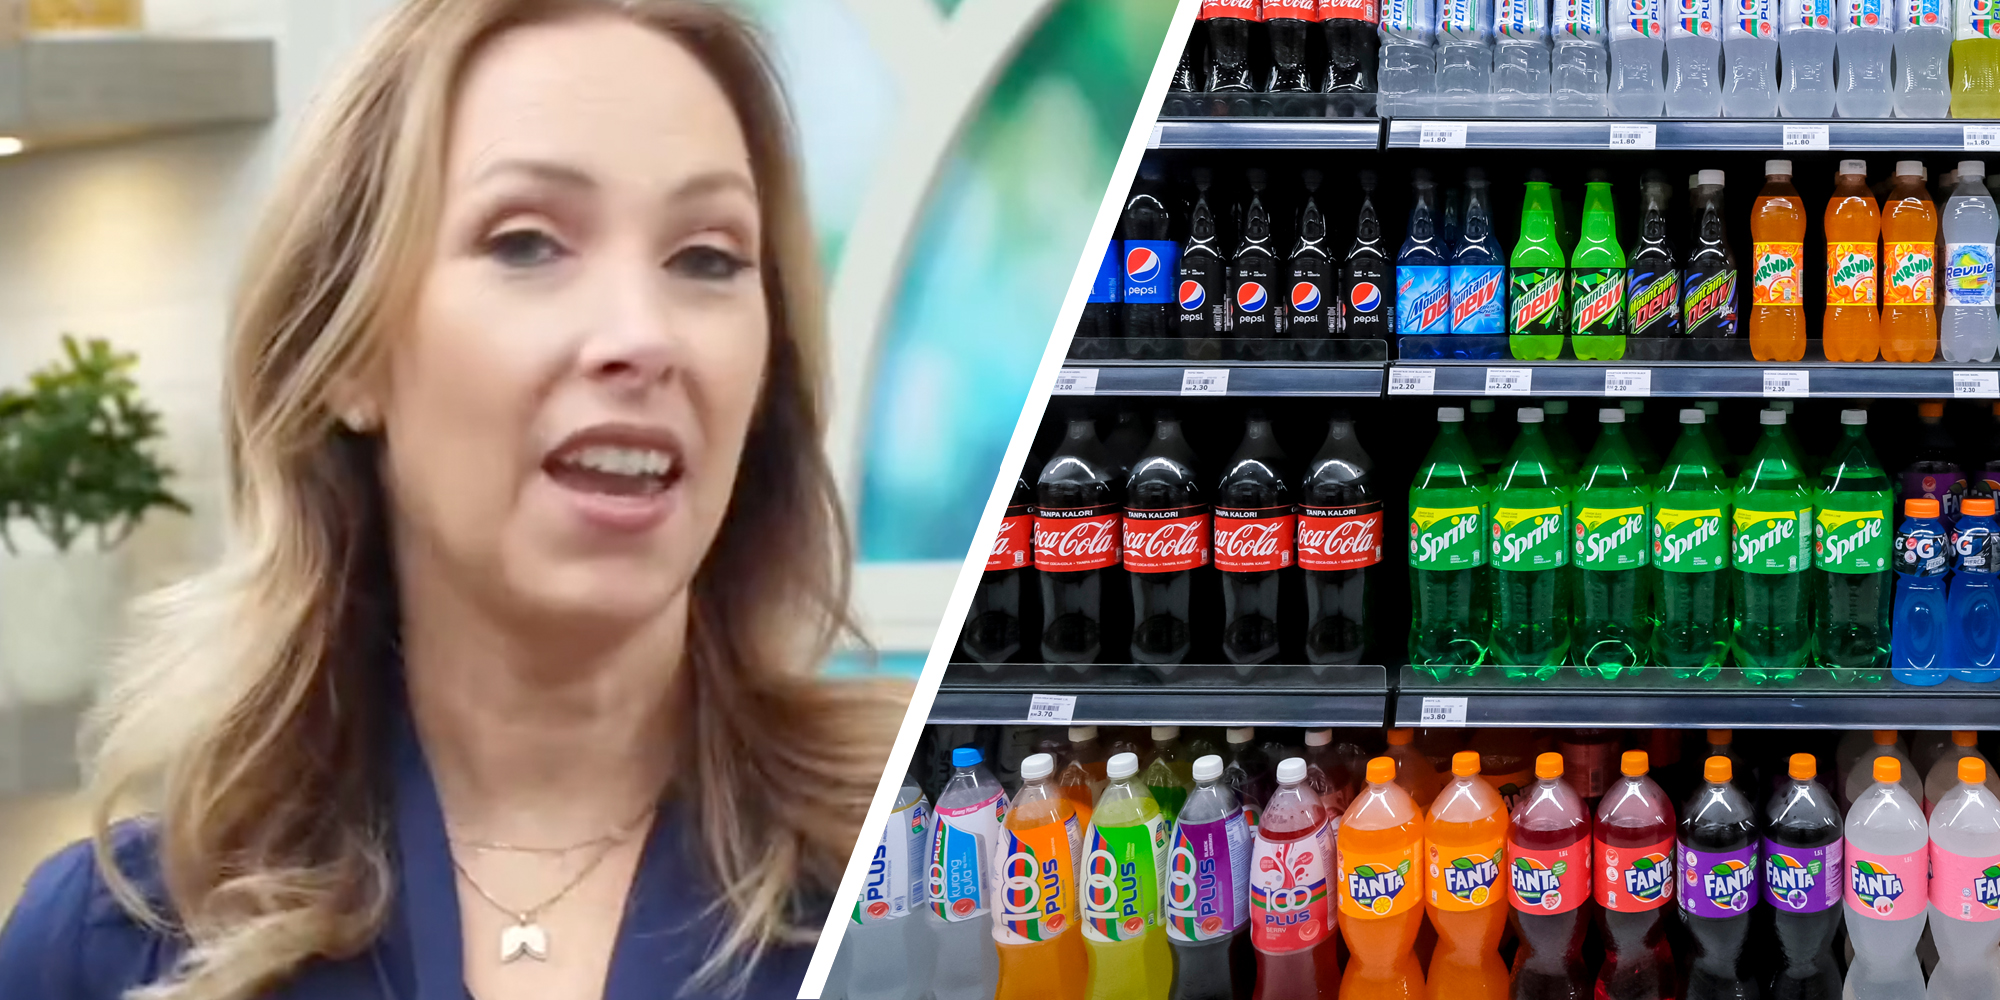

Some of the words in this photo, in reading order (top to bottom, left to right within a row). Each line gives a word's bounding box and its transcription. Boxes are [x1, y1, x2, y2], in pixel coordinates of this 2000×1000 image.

[1755, 256, 1795, 287] MIRINDA
[1834, 256, 1876, 286] MIRINDA
[1892, 256, 1932, 287] MIRINDA
[1128, 286, 1157, 296] pepsi
[1410, 280, 1450, 320] Mounta
[1511, 276, 1555, 317] Mountain
[1572, 276, 1616, 317] Mountain
[1630, 276, 1672, 315] Mountain
[1180, 313, 1204, 322] pepsi
[1240, 314, 1265, 324] pepsi
[1294, 314, 1318, 324] pepsi
[1354, 314, 1380, 324] pepsi
[1298, 518, 1377, 556] Coca-Cola
[1419, 514, 1477, 562] Sprite
[1502, 514, 1560, 563] Sprite
[1586, 514, 1642, 562] Sprite
[1663, 516, 1719, 563] Sprite
[1738, 519, 1794, 564] Sprite
[1825, 518, 1881, 564] Sprite
[1916, 538, 1934, 558] G
[1956, 536, 1973, 555] G
[934, 831, 943, 860] PLUS
[867, 845, 886, 900] PLUS
[928, 864, 947, 904] 100
[950, 860, 962, 898] kurang
[961, 870, 976, 895] gula
[1085, 850, 1120, 922] 100
[1121, 862, 1138, 916] PLUS
[1167, 846, 1198, 920] 100
[1200, 858, 1217, 916] PLUS
[1349, 870, 1404, 898] FANTA
[1445, 860, 1499, 890] FANTA
[1511, 864, 1559, 891] FANTA
[1625, 858, 1672, 892] FANTA
[1704, 866, 1754, 896] FANTA
[1766, 860, 1815, 888] FANTA
[1851, 867, 1902, 895] FANTA
[1001, 852, 1042, 926] 100
[1042, 858, 1060, 915] PLUS
[1263, 885, 1312, 913] 100
[1976, 878, 2000, 900] FA
[1266, 910, 1310, 926] PLUS
